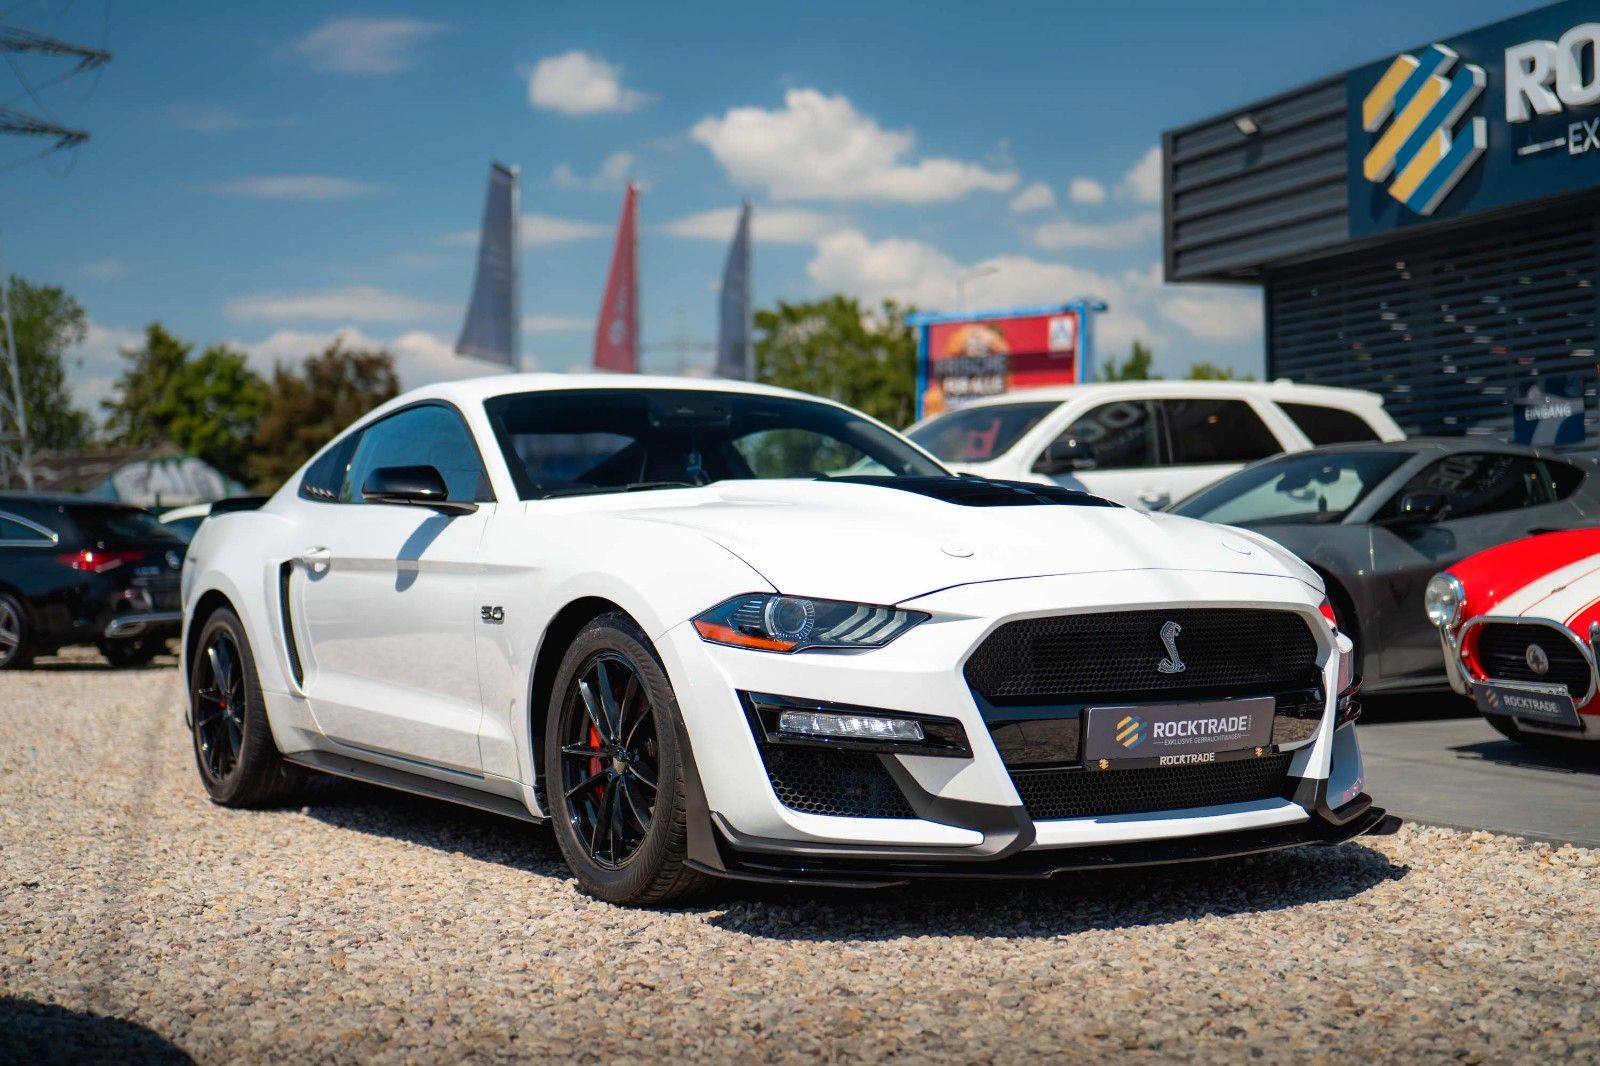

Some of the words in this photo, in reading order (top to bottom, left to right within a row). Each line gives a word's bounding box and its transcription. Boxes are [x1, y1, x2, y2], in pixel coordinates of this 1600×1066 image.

[1525, 404, 1572, 421] EINGANG
[1503, 695, 1560, 713] ROCKTRADE
[1153, 715, 1248, 738] ROCKTRADE
[1164, 738, 1193, 746] EXKLUSIVE
[1194, 733, 1241, 744] GEBRAUCHTWAGEN
[1160, 752, 1216, 766] ROCKTRADE
